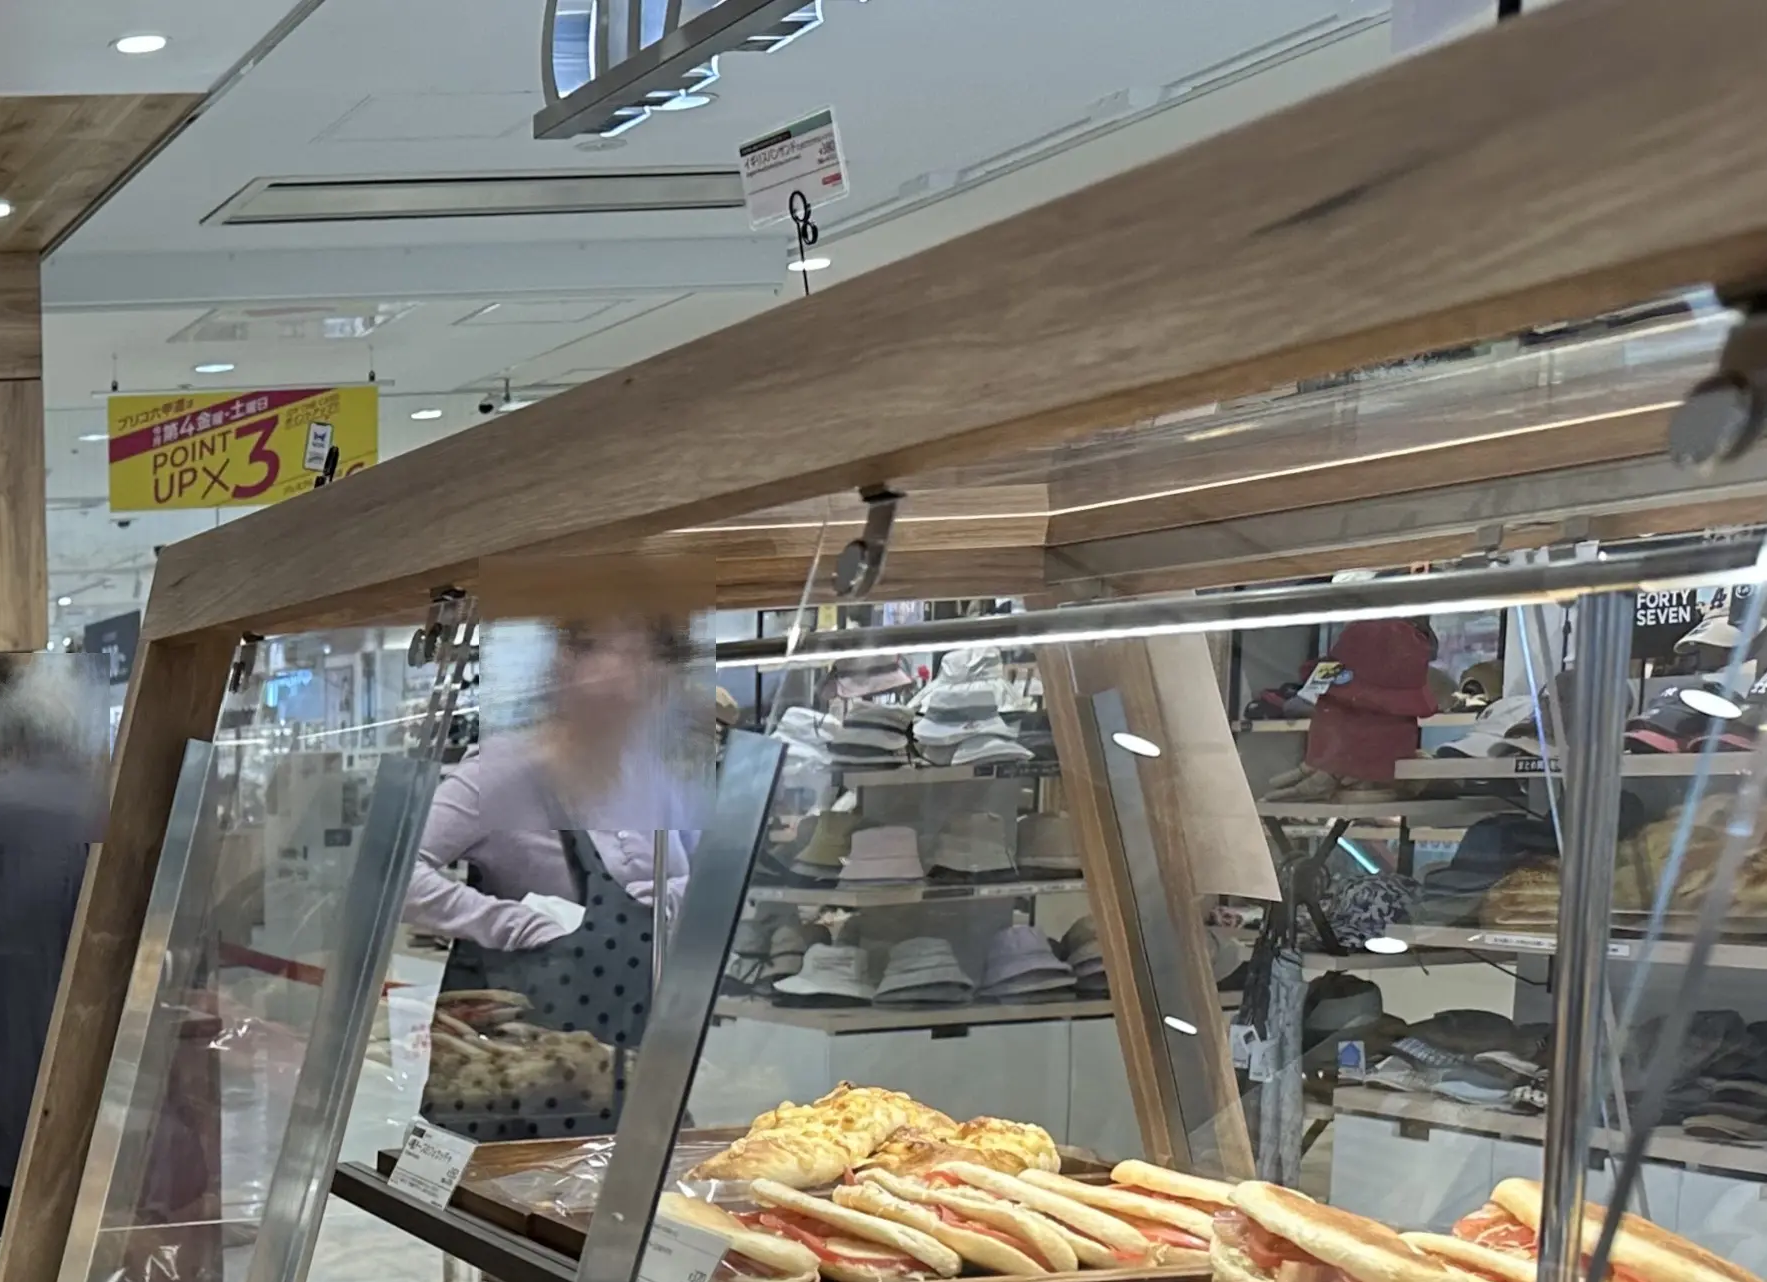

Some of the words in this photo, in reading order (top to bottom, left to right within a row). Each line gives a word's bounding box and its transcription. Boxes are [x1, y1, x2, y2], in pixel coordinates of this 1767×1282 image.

[152, 430, 233, 475] POINT
[1636, 588, 1691, 609] FORTY
[1636, 605, 1691, 626] SEVEN
